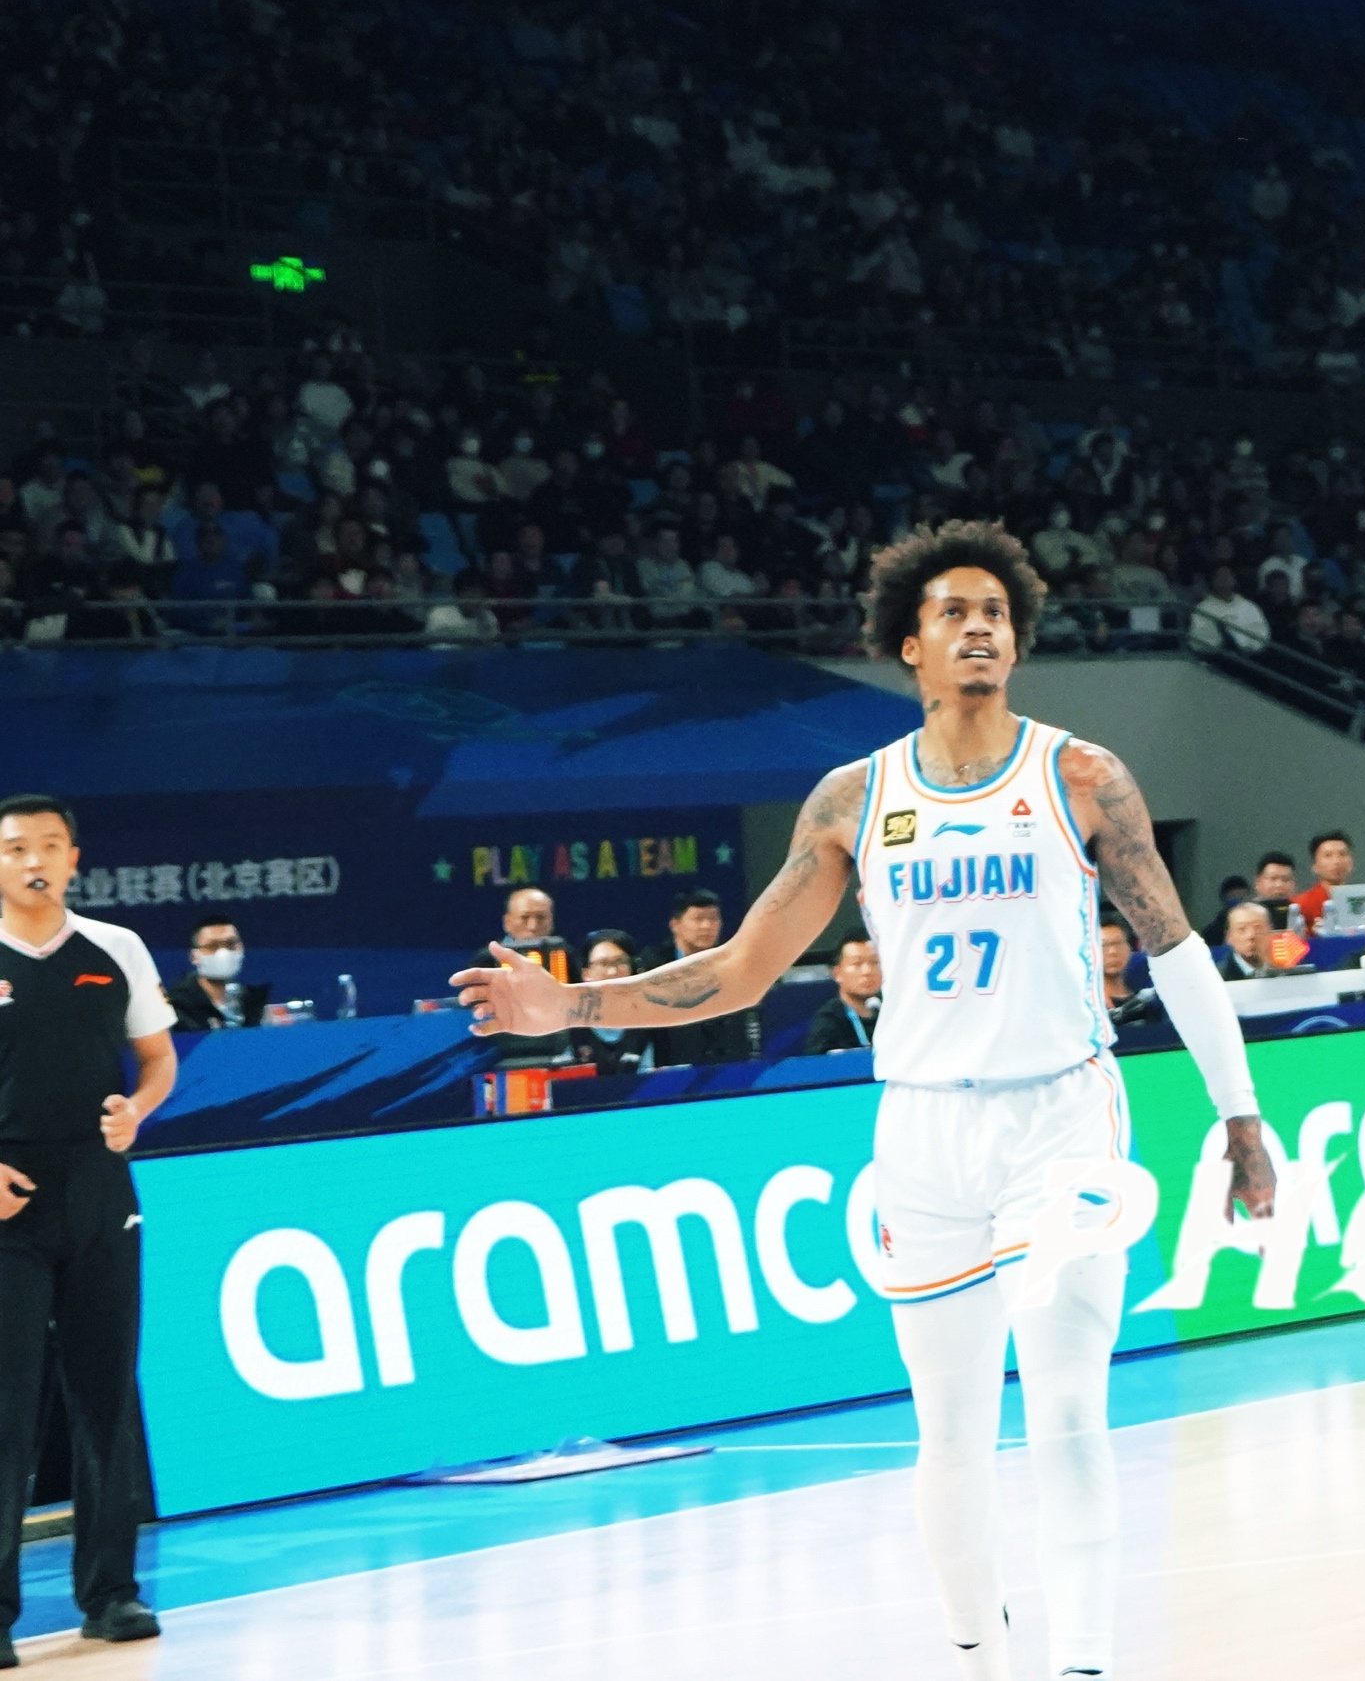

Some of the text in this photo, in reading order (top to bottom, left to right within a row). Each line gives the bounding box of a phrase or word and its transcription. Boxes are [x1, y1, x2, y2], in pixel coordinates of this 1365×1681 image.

[472, 834, 698, 887] PLAY AS A TEAM
[888, 852, 1038, 907] FUJIAN
[925, 929, 1007, 1000] 27
[219, 1163, 884, 1401] aramc
